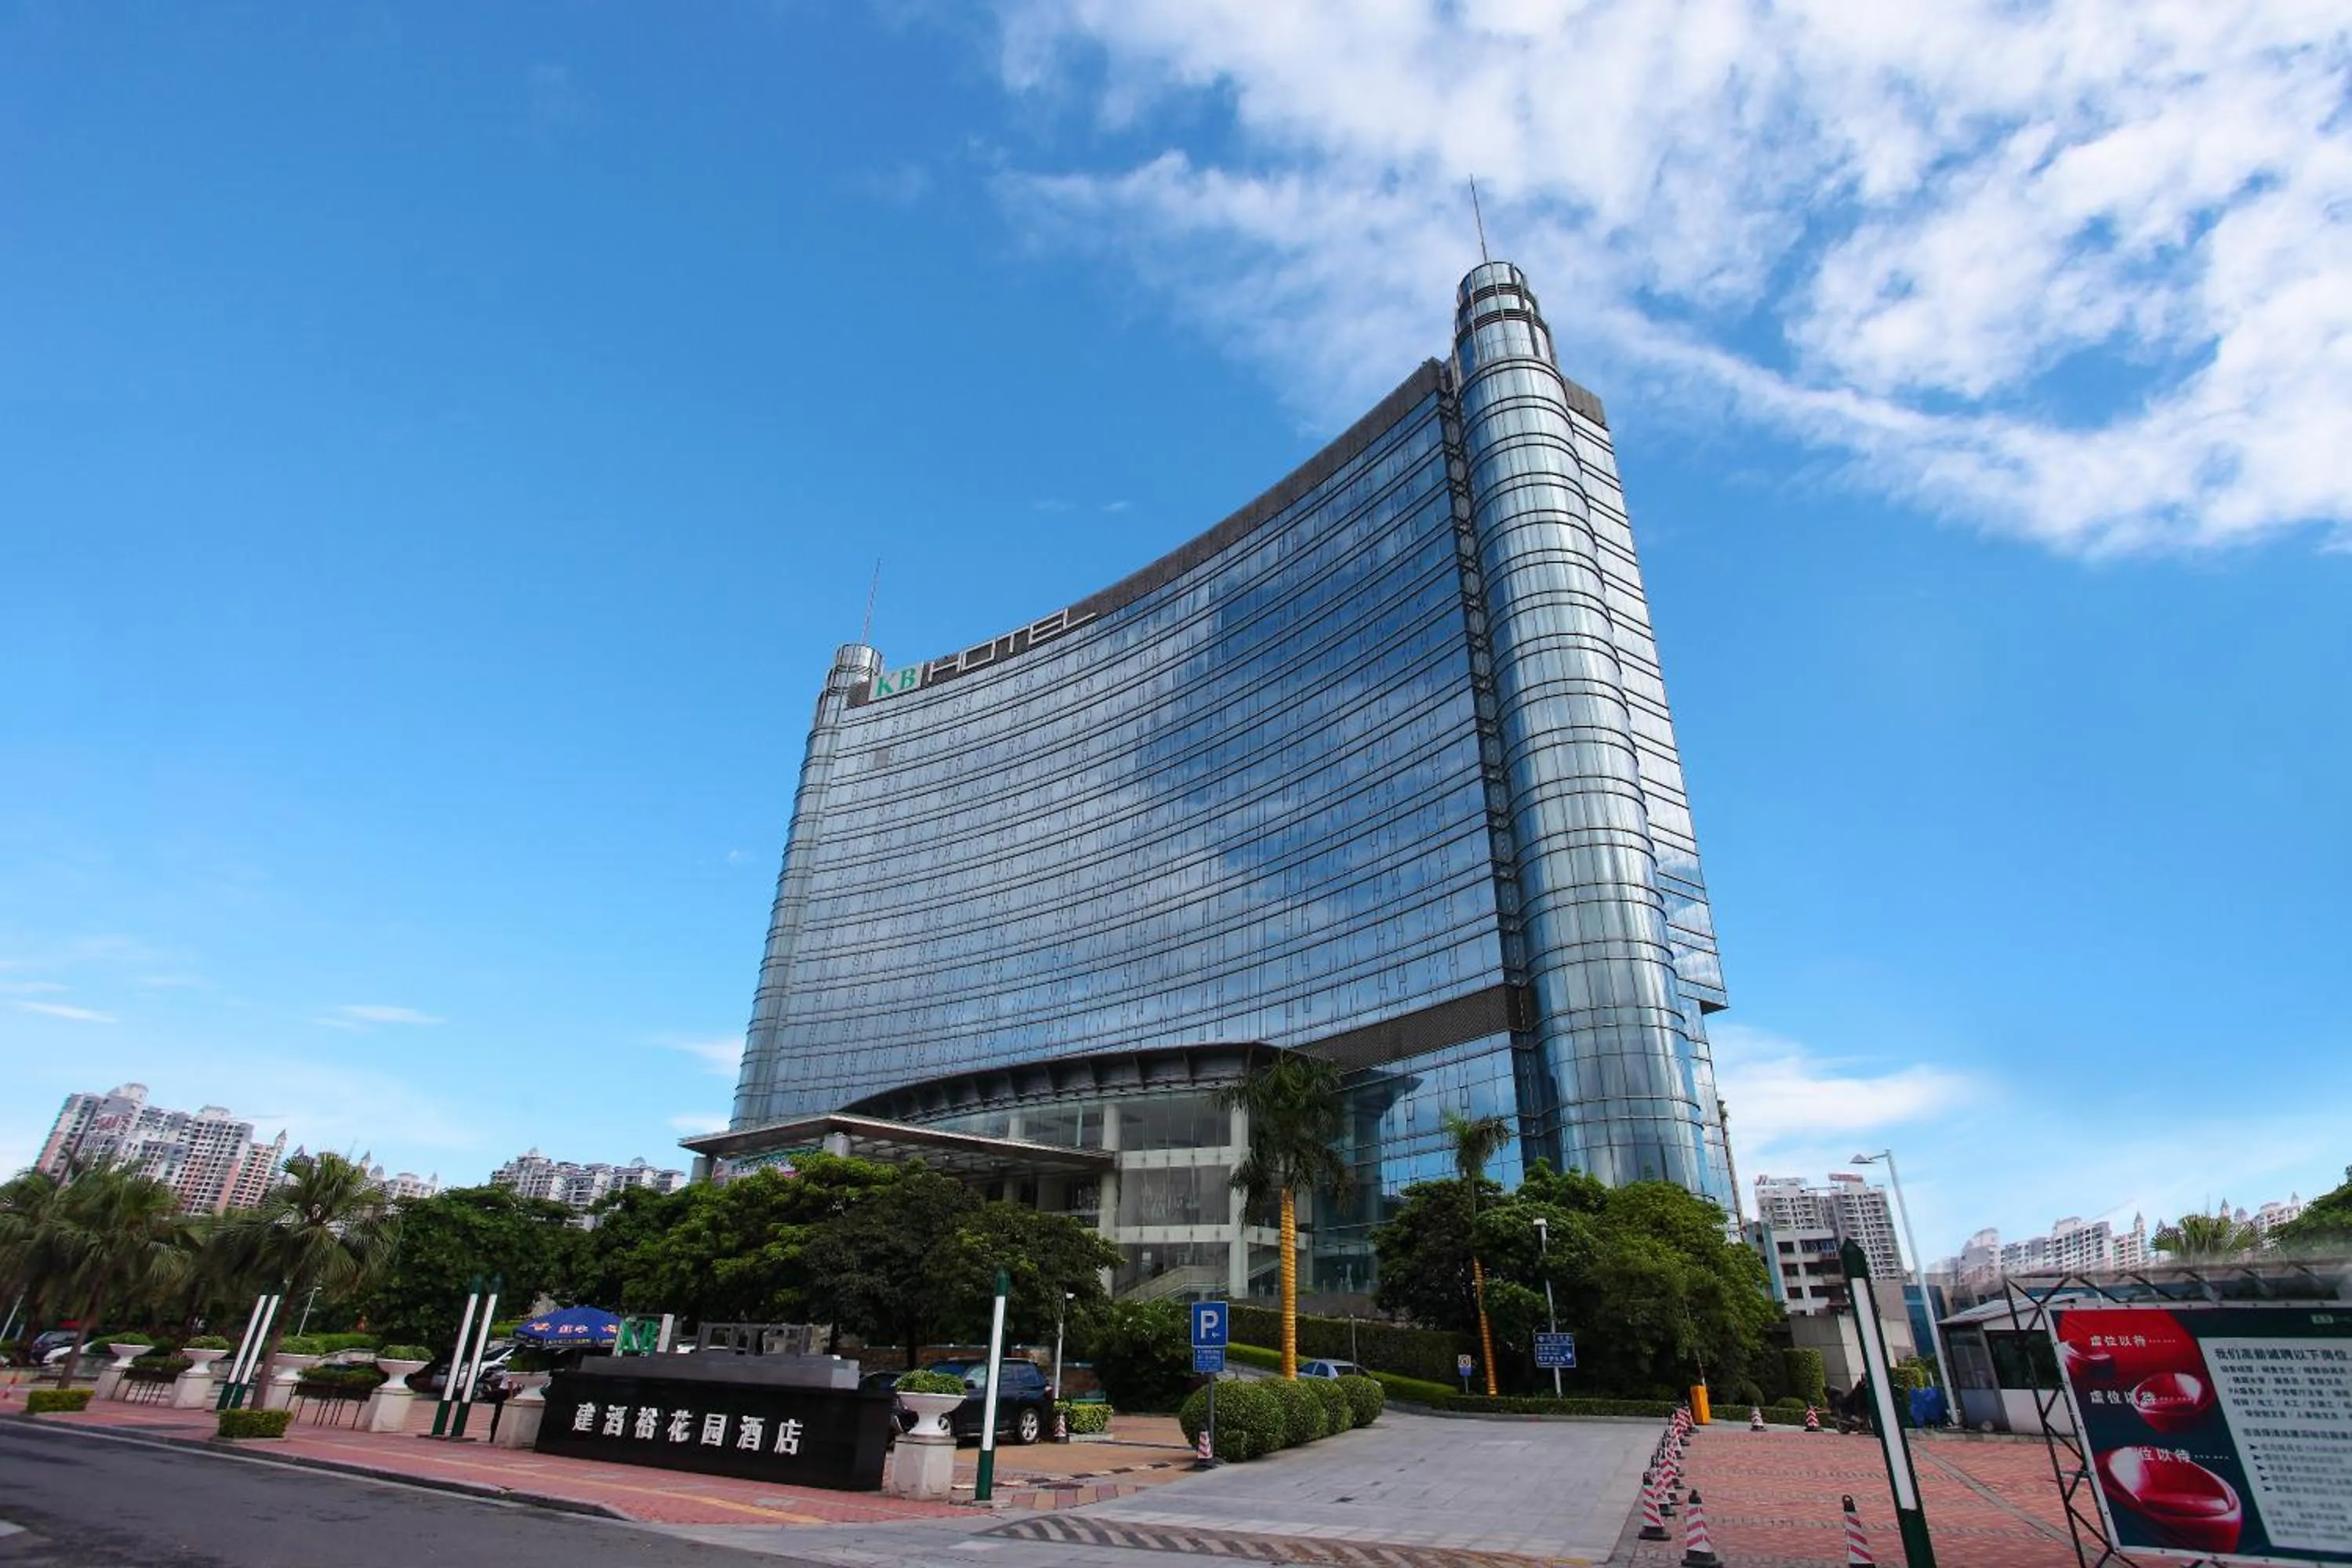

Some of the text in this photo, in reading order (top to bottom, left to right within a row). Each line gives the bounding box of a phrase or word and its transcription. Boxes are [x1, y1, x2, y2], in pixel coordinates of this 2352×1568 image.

[876, 608, 1097, 697] KB HOTEL
[1200, 1310, 1219, 1339] P
